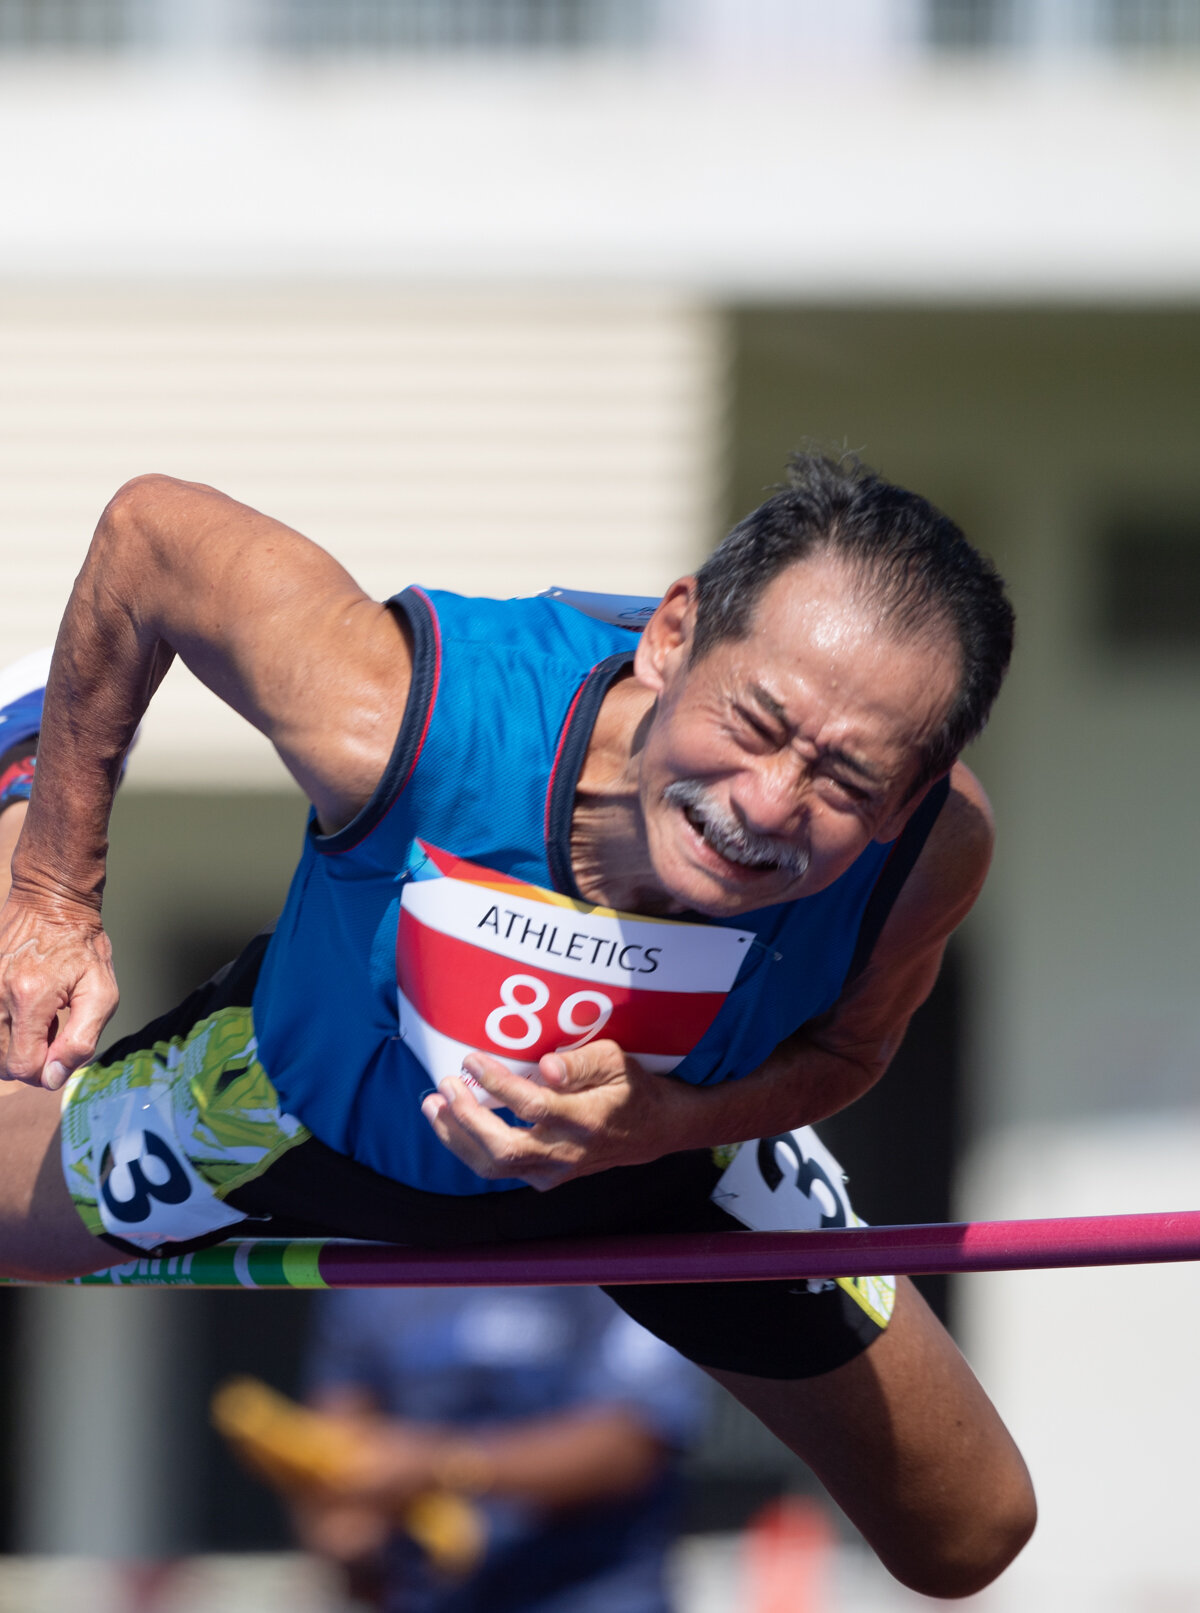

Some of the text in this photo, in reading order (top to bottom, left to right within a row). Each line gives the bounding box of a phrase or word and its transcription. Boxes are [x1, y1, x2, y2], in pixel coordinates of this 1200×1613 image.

[477, 904, 664, 974] ATHLETICS
[484, 973, 614, 1053] 89
[99, 1128, 193, 1224] 3
